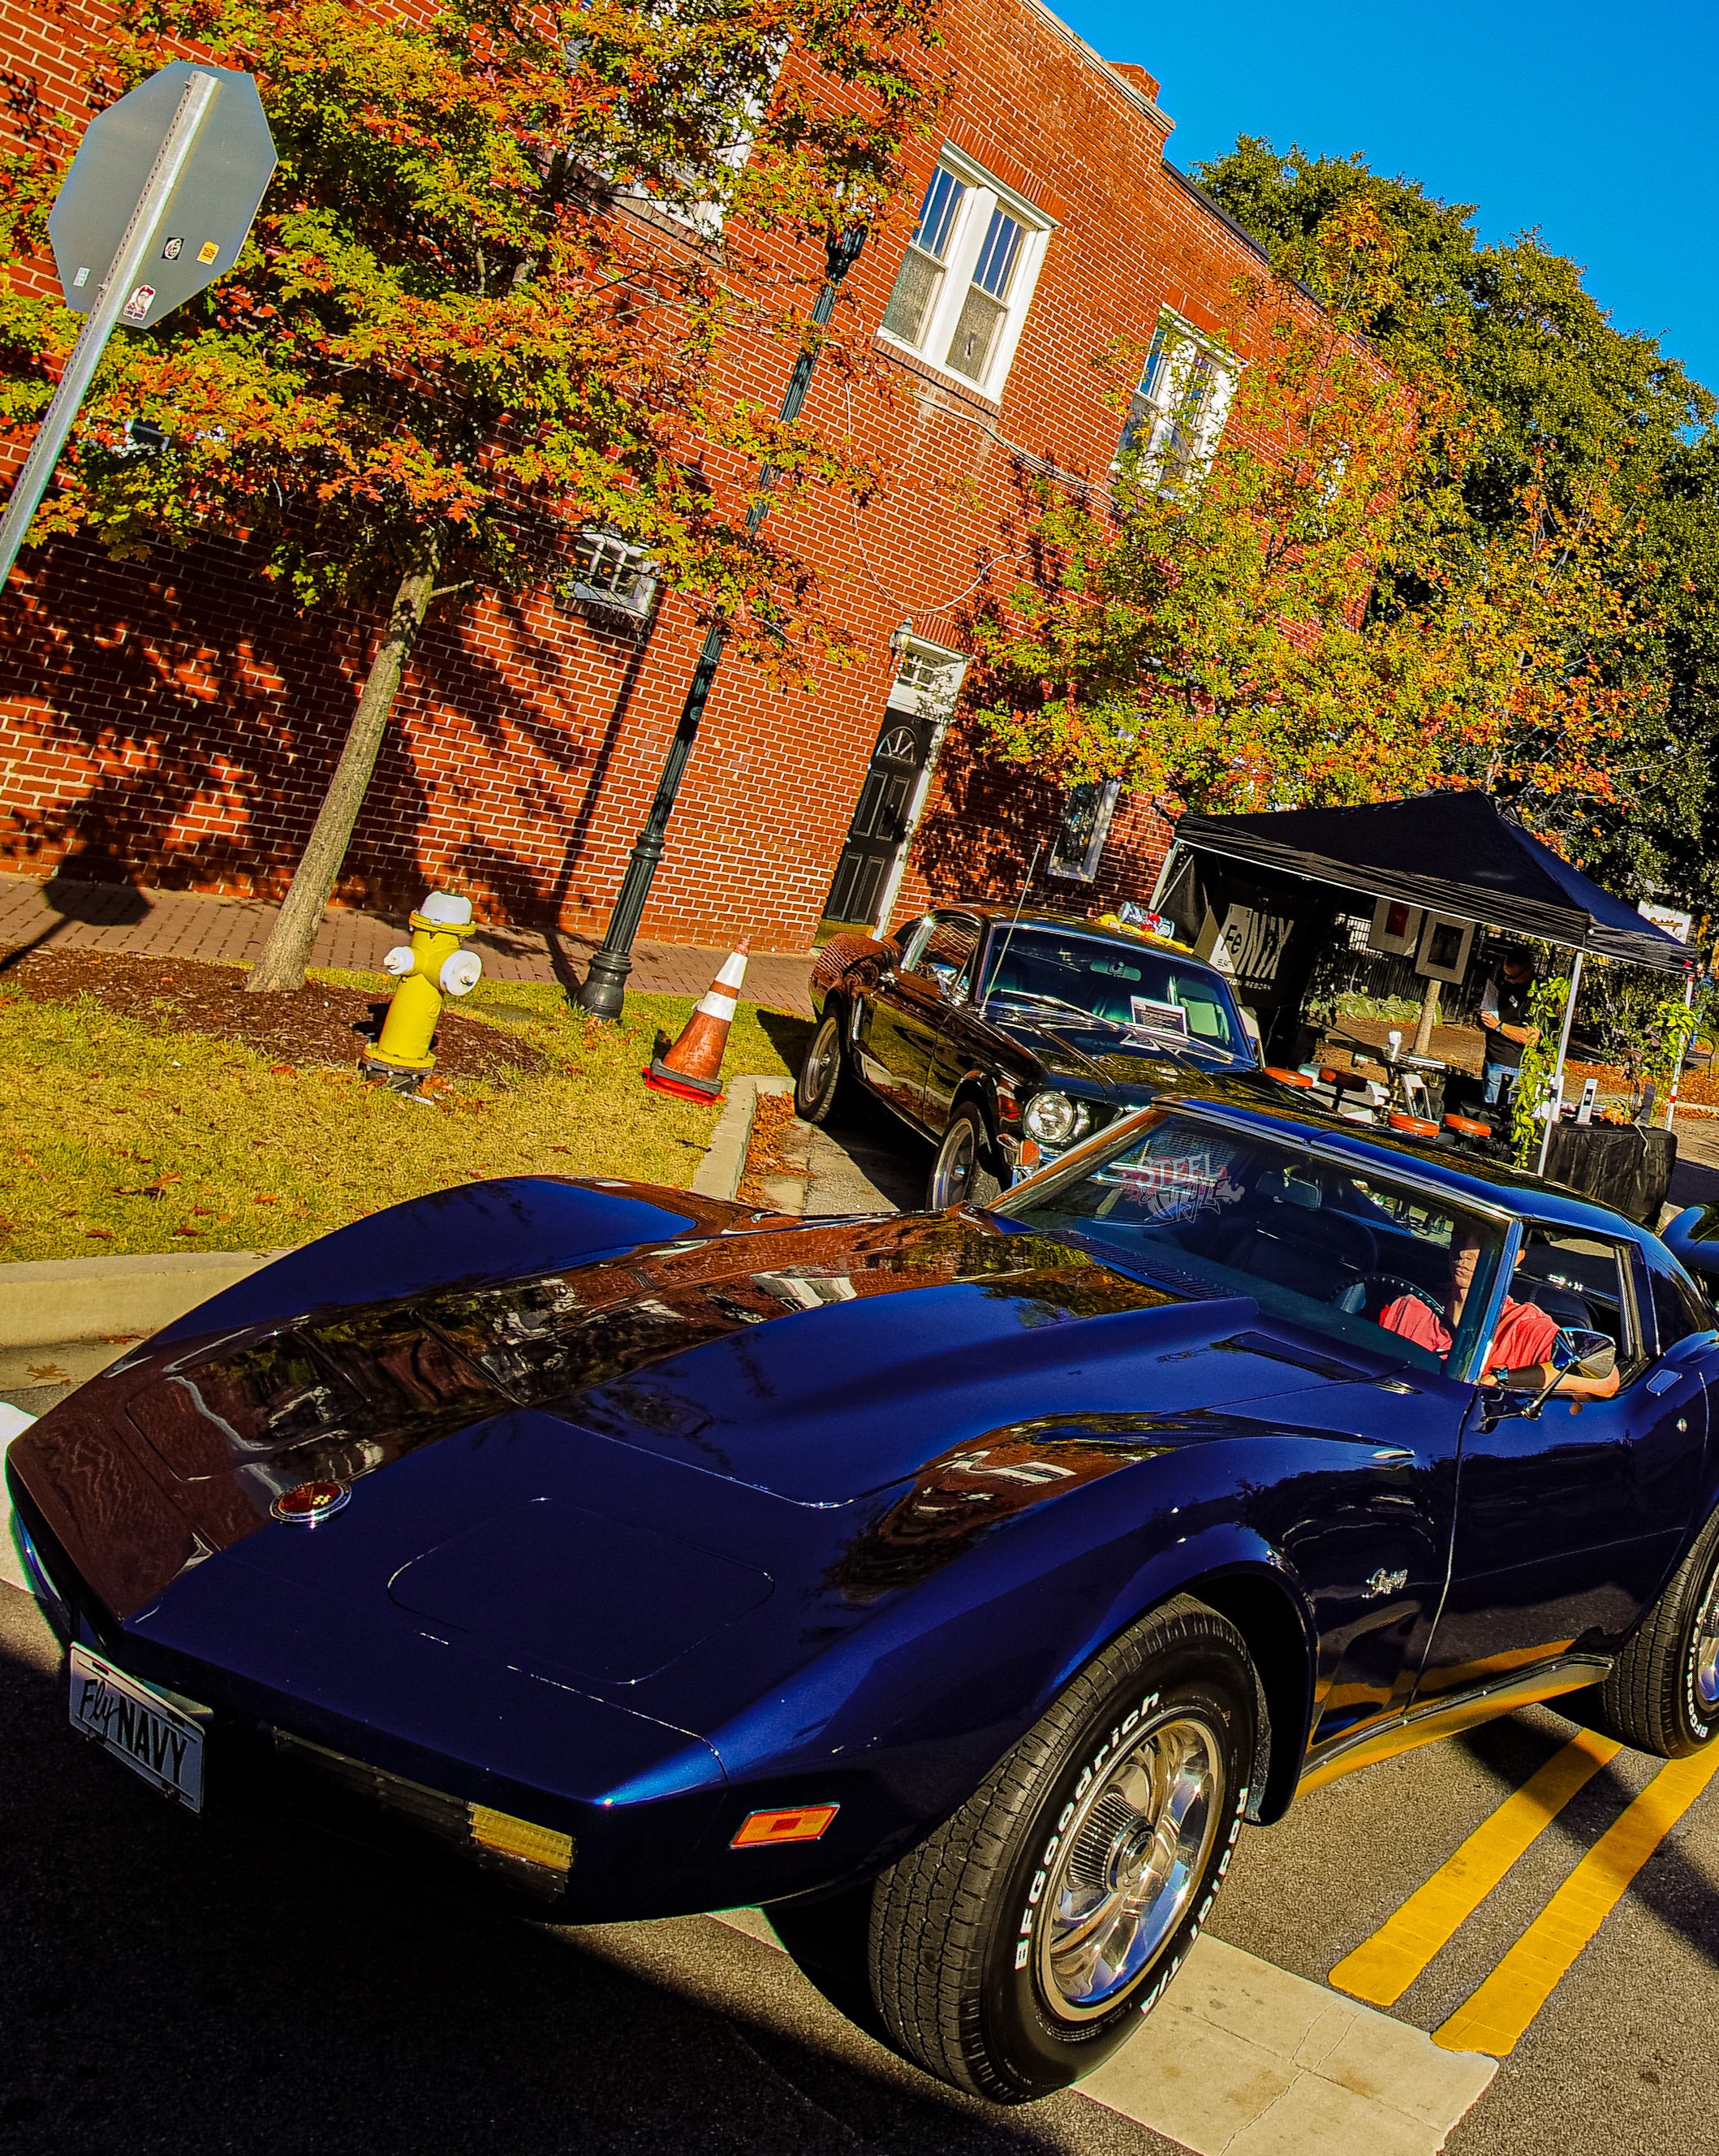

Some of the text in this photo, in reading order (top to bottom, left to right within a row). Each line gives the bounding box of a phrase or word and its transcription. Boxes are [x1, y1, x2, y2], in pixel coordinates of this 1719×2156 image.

[1244, 981, 1272, 990] REBORN
[79, 1679, 188, 1785] Fly NAVY
[1015, 1692, 1160, 1970] BFGoodrich
[1140, 1787, 1249, 2015] Radial T/A
